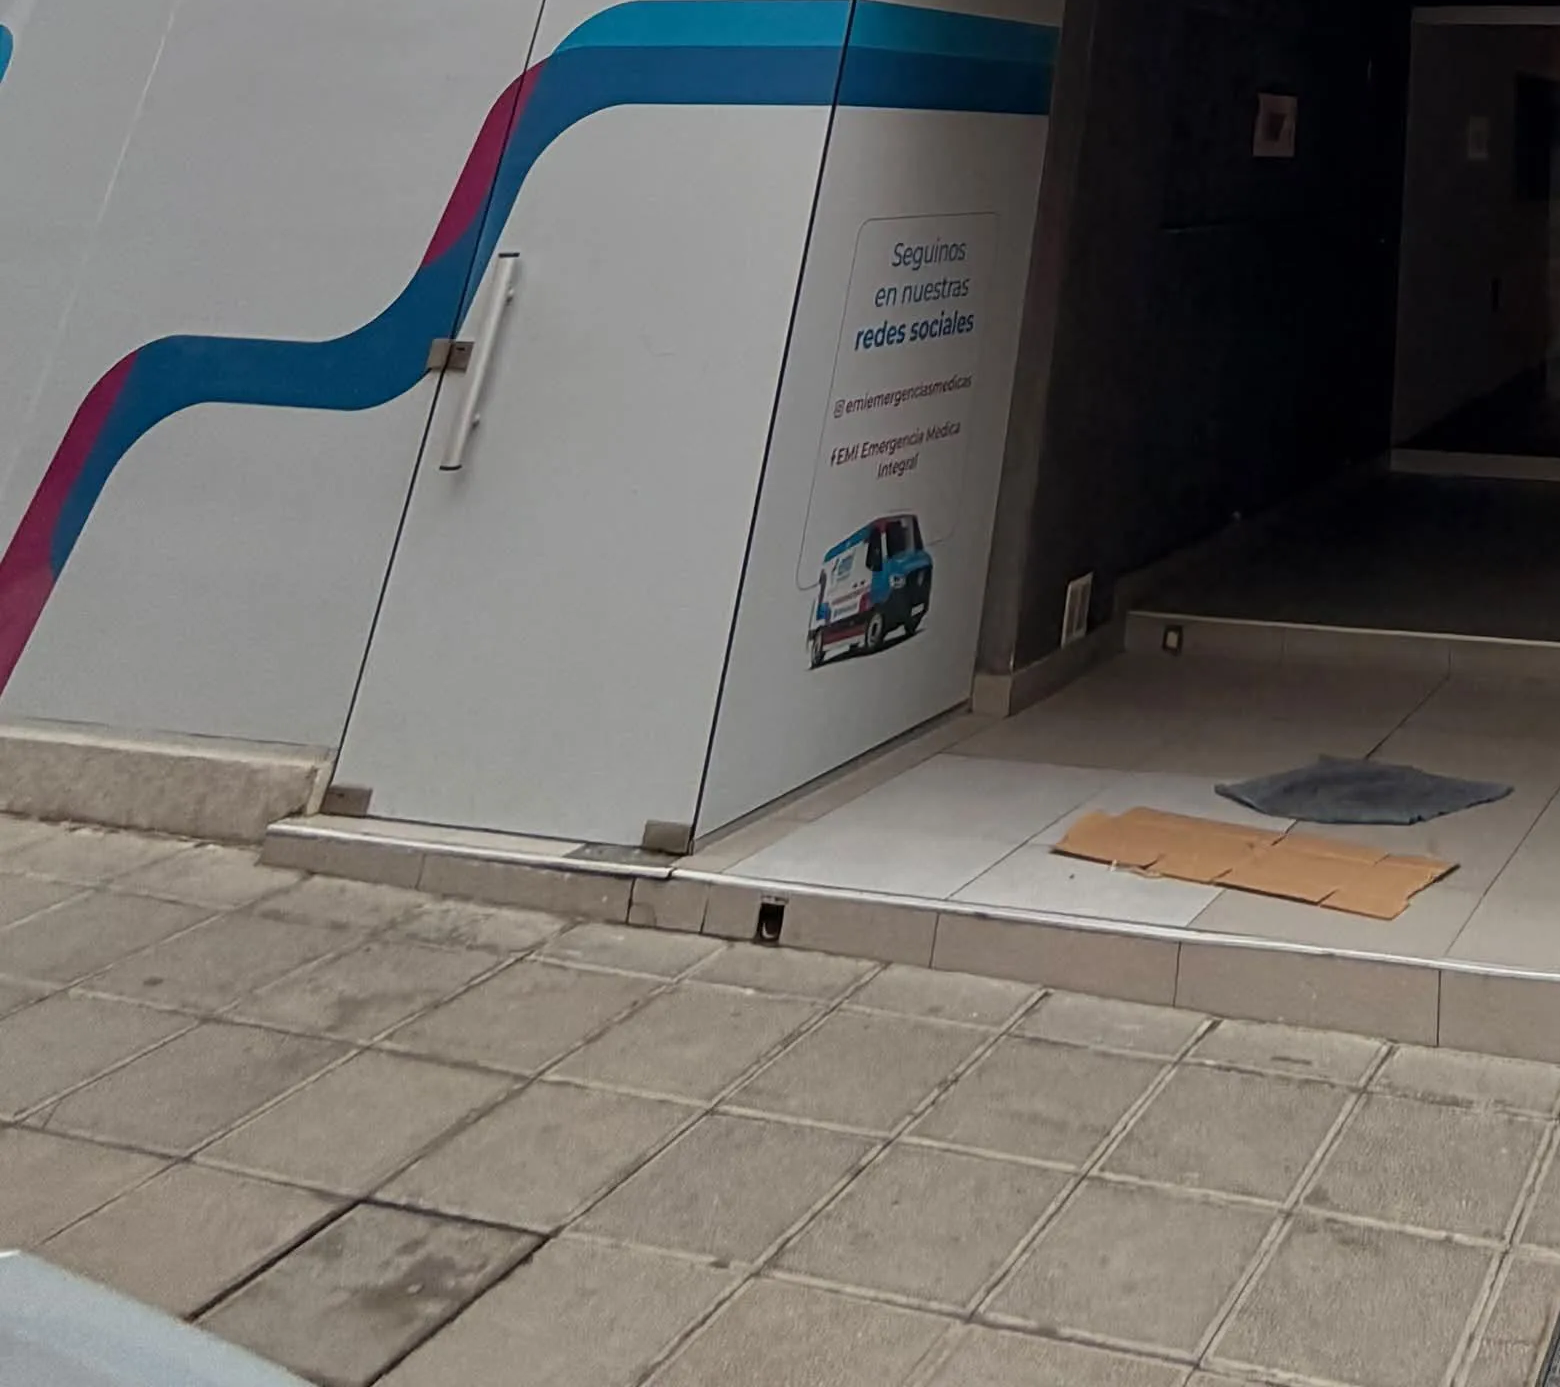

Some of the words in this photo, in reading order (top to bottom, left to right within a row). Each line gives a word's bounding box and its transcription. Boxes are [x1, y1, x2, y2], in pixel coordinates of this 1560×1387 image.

[891, 237, 967, 271] Seguinos
[874, 286, 897, 307] en
[901, 277, 971, 304] nuestras
[854, 319, 906, 351] redes
[909, 309, 974, 342] sociales
[836, 443, 860, 466] EMI
[861, 428, 925, 458] Emergencia
[877, 452, 920, 479] Integral
